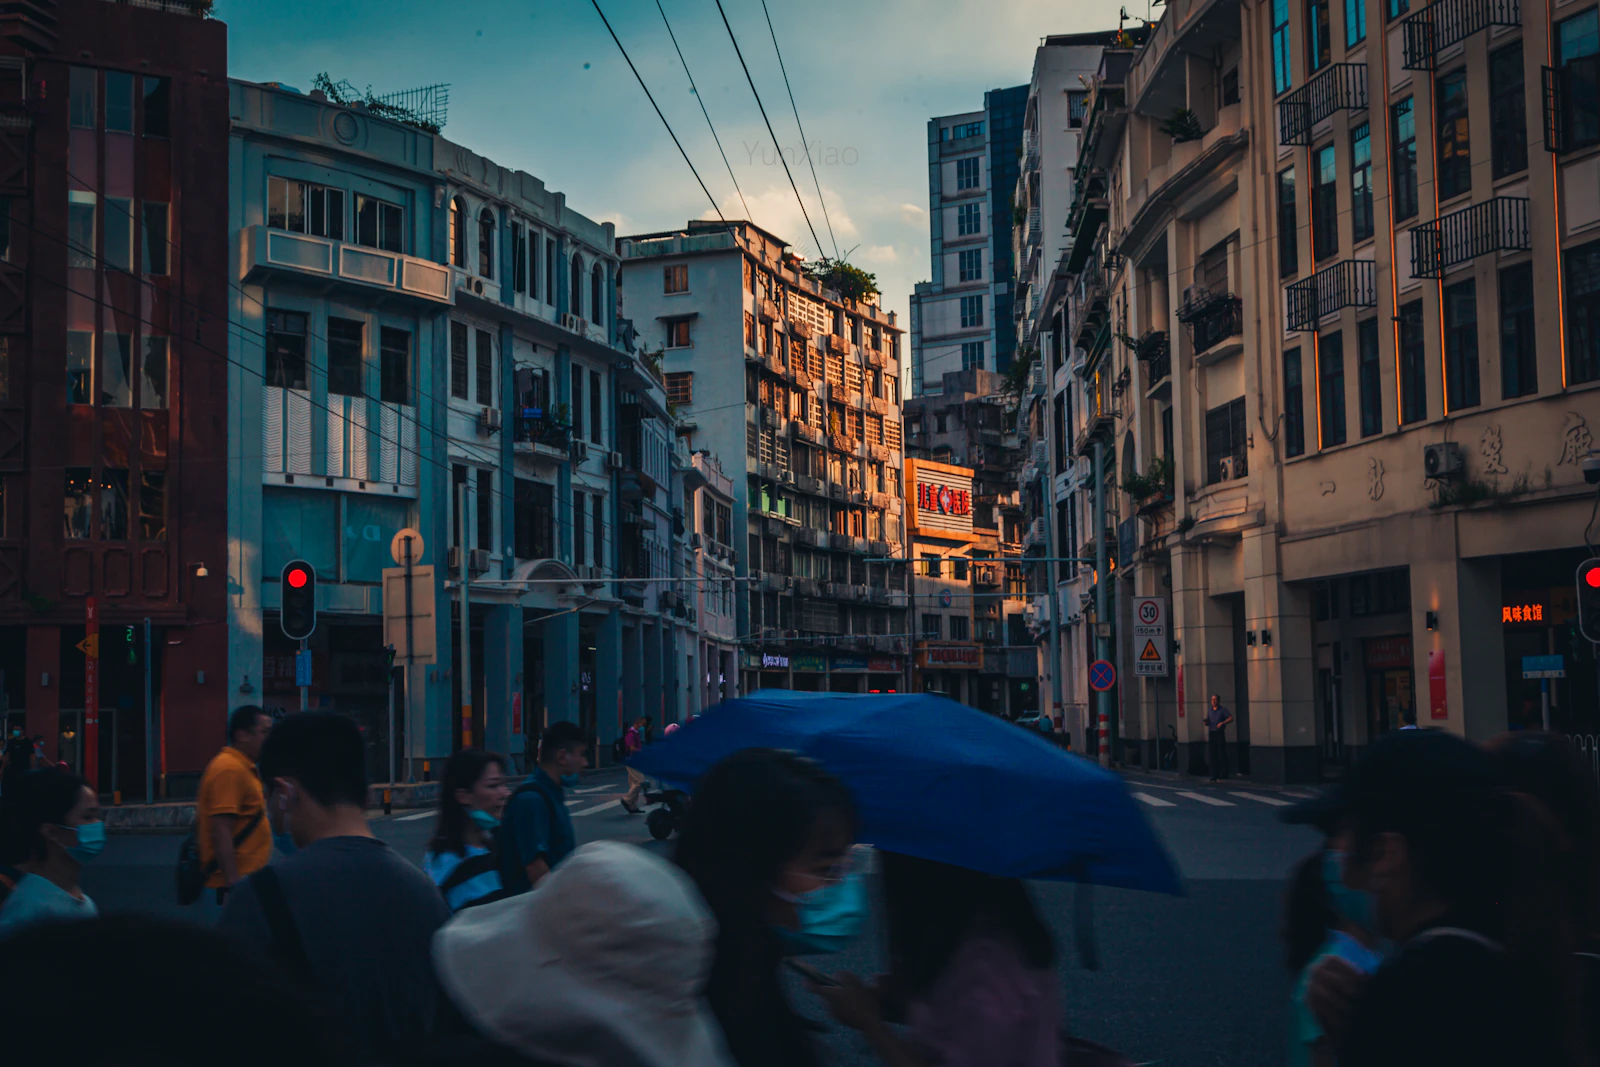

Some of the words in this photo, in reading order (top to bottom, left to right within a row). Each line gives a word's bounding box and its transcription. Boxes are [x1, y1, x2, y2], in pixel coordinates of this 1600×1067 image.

[919, 482, 971, 516] 儿童医院
[1143, 606, 1155, 618] 30
[1502, 603, 1543, 623] 风味食馆
[1138, 664, 1163, 672] 学校区域
